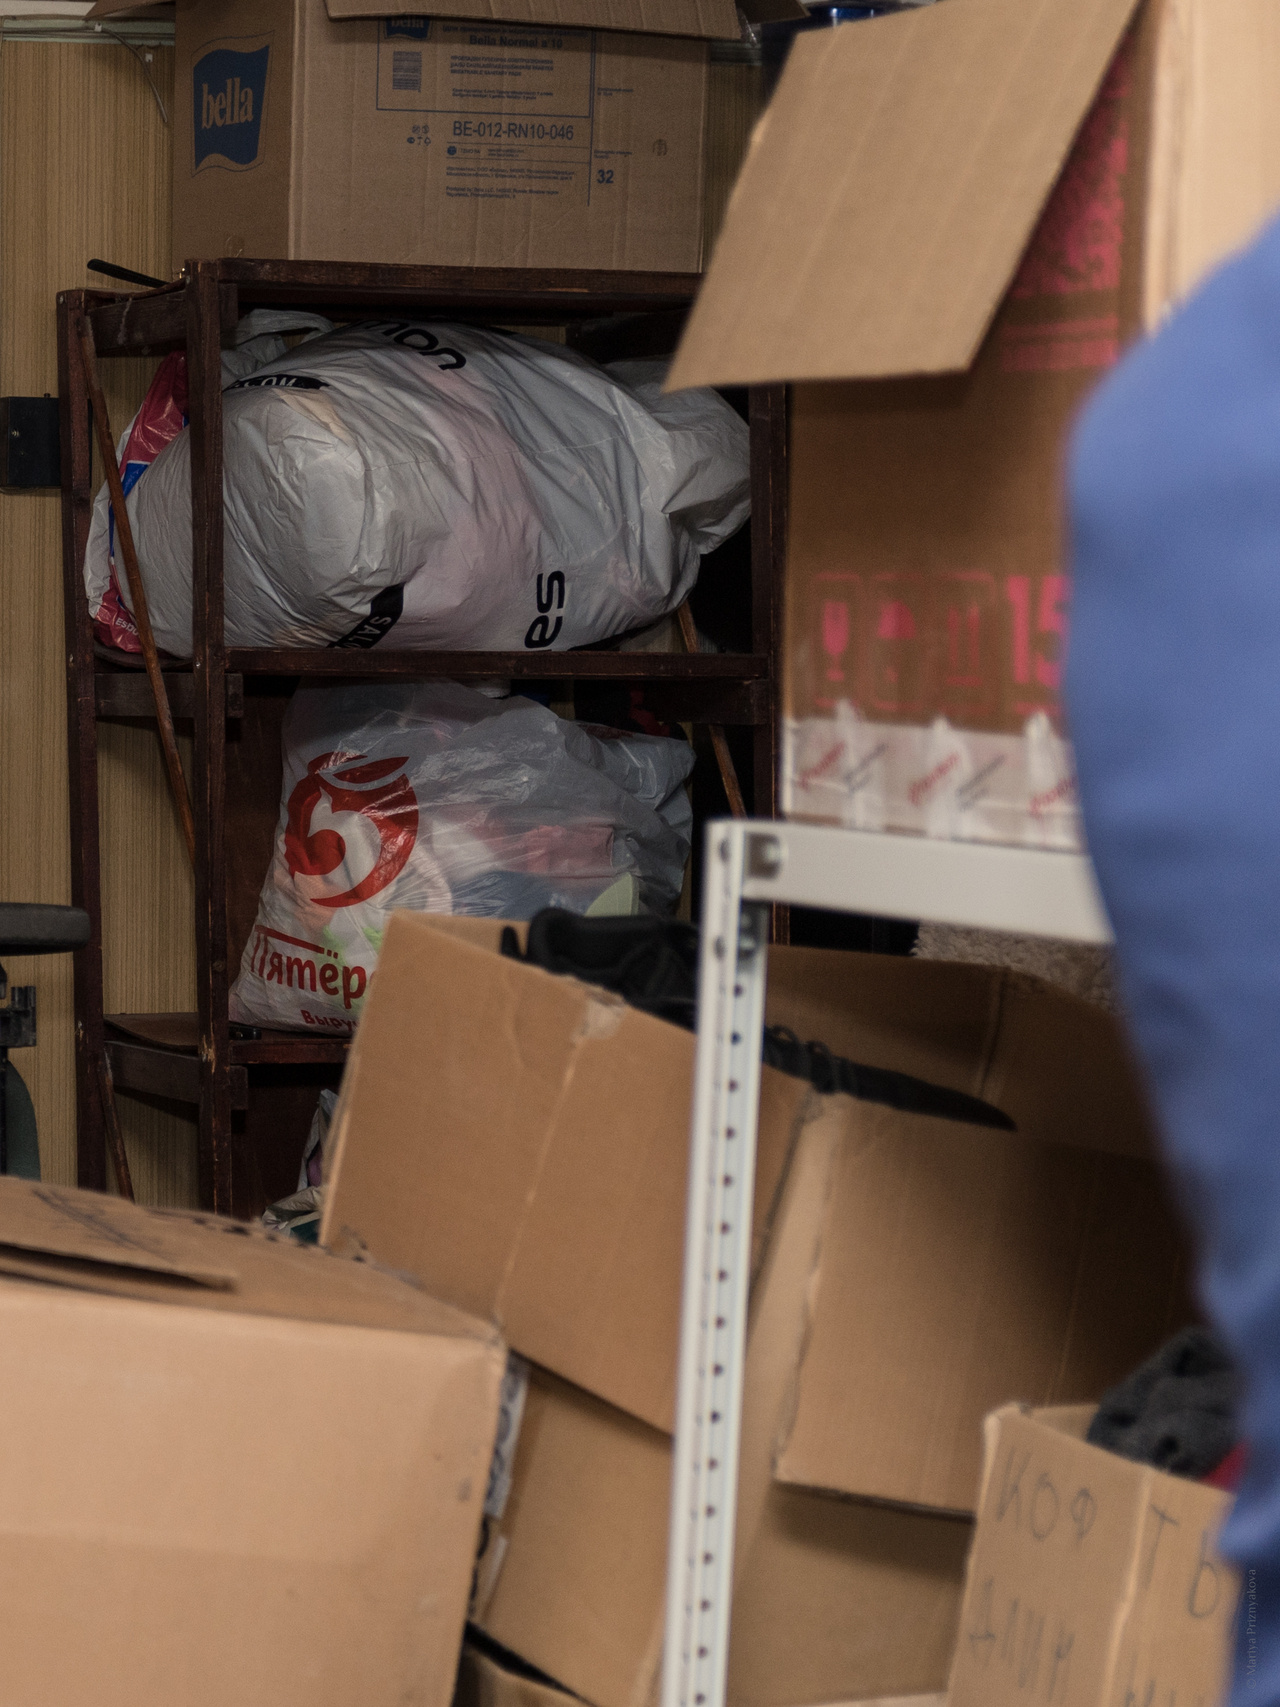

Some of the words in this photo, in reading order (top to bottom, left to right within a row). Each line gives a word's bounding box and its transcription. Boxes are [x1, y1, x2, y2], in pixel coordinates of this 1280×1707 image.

[469, 34, 496, 46] Bella
[500, 35, 538, 47] Normal
[201, 77, 254, 130] bella
[452, 120, 574, 141] BE-012-RN10-046
[596, 169, 615, 185] 32
[251, 925, 373, 1010] Пятёр
[300, 1010, 359, 1032] Выру
